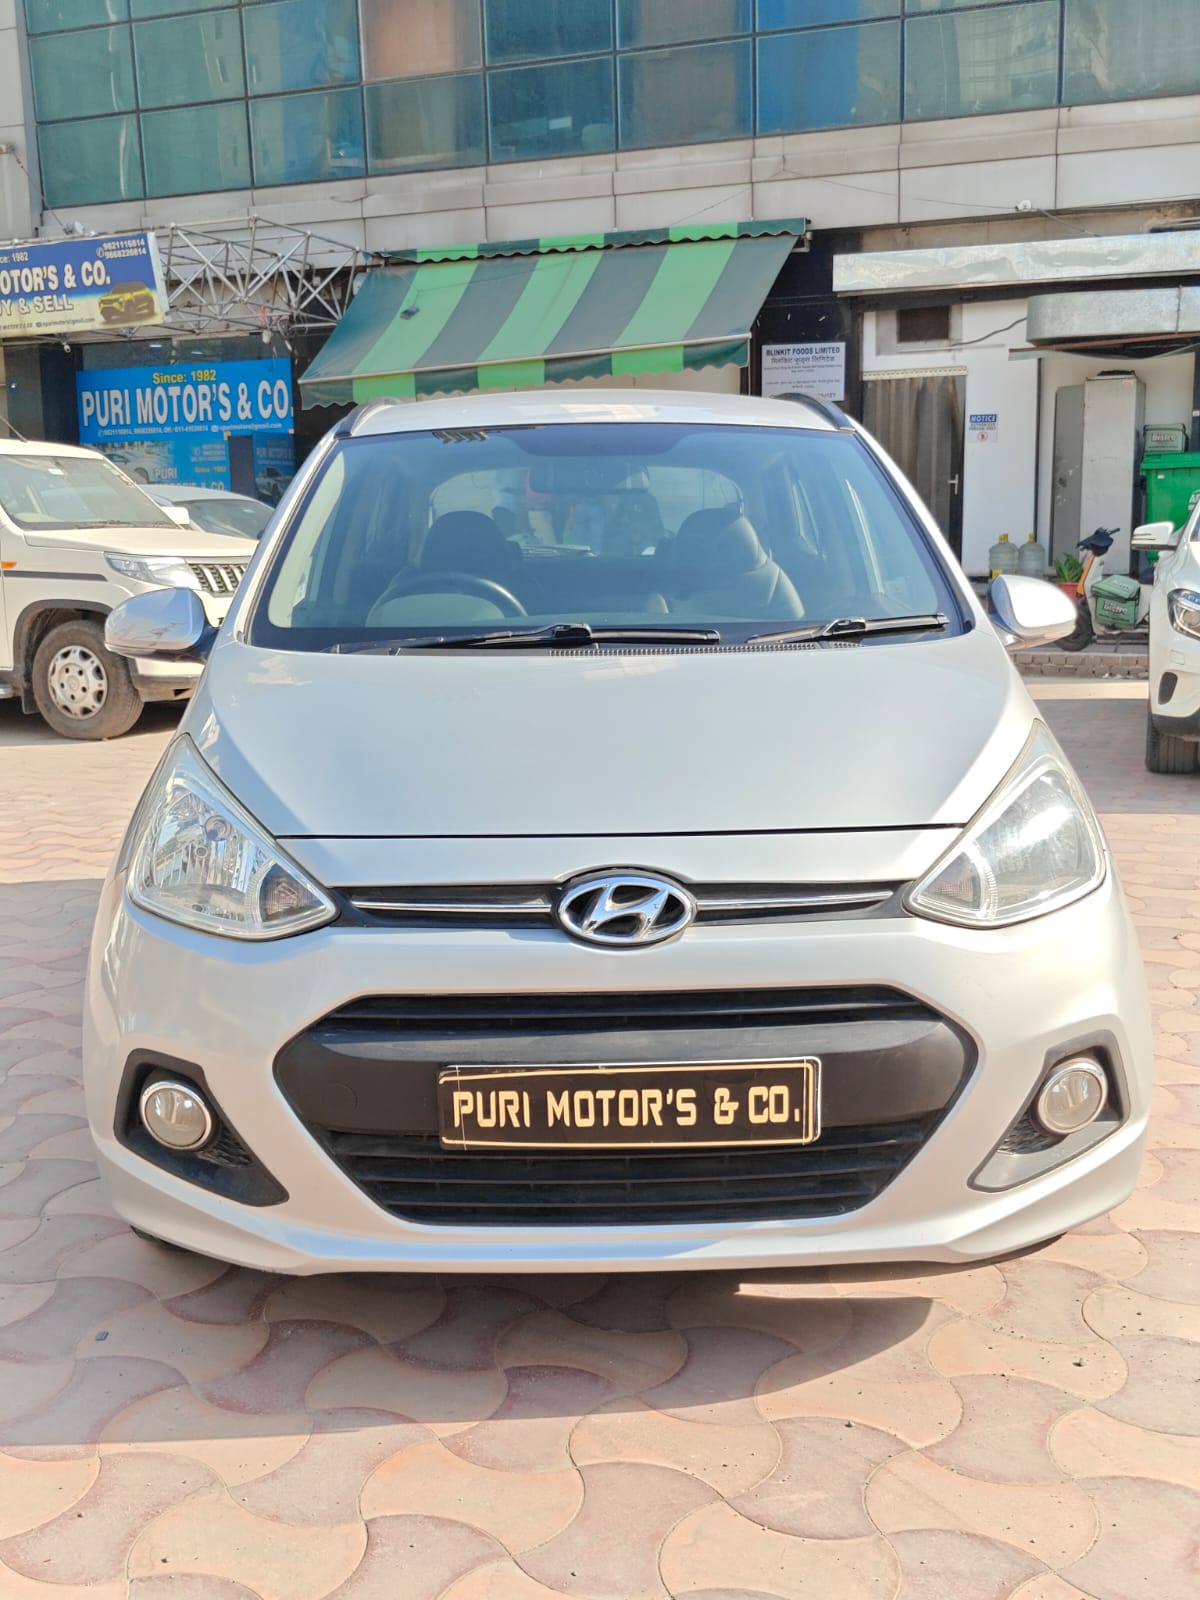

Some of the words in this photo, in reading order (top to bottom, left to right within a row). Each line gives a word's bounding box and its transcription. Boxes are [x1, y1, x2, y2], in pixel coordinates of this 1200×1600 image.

[12, 252, 29, 262] 1982
[64, 263, 77, 289] &
[81, 259, 111, 286] CO.
[0, 298, 12, 316] Y
[18, 297, 30, 314] &
[33, 294, 74, 314] SELL
[792, 347, 813, 355] FOODS
[814, 346, 841, 355] LIMITED
[152, 372, 187, 385] Since:
[191, 369, 217, 382] 1982
[82, 388, 131, 427] PURI
[135, 382, 232, 424] MOTOR'S
[237, 382, 253, 420] &
[154, 467, 177, 479] PURI
[453, 1090, 530, 1128] PURI
[547, 1088, 697, 1128] MOTOR'S
[713, 1087, 739, 1126] &
[748, 1085, 801, 1125] CO.
